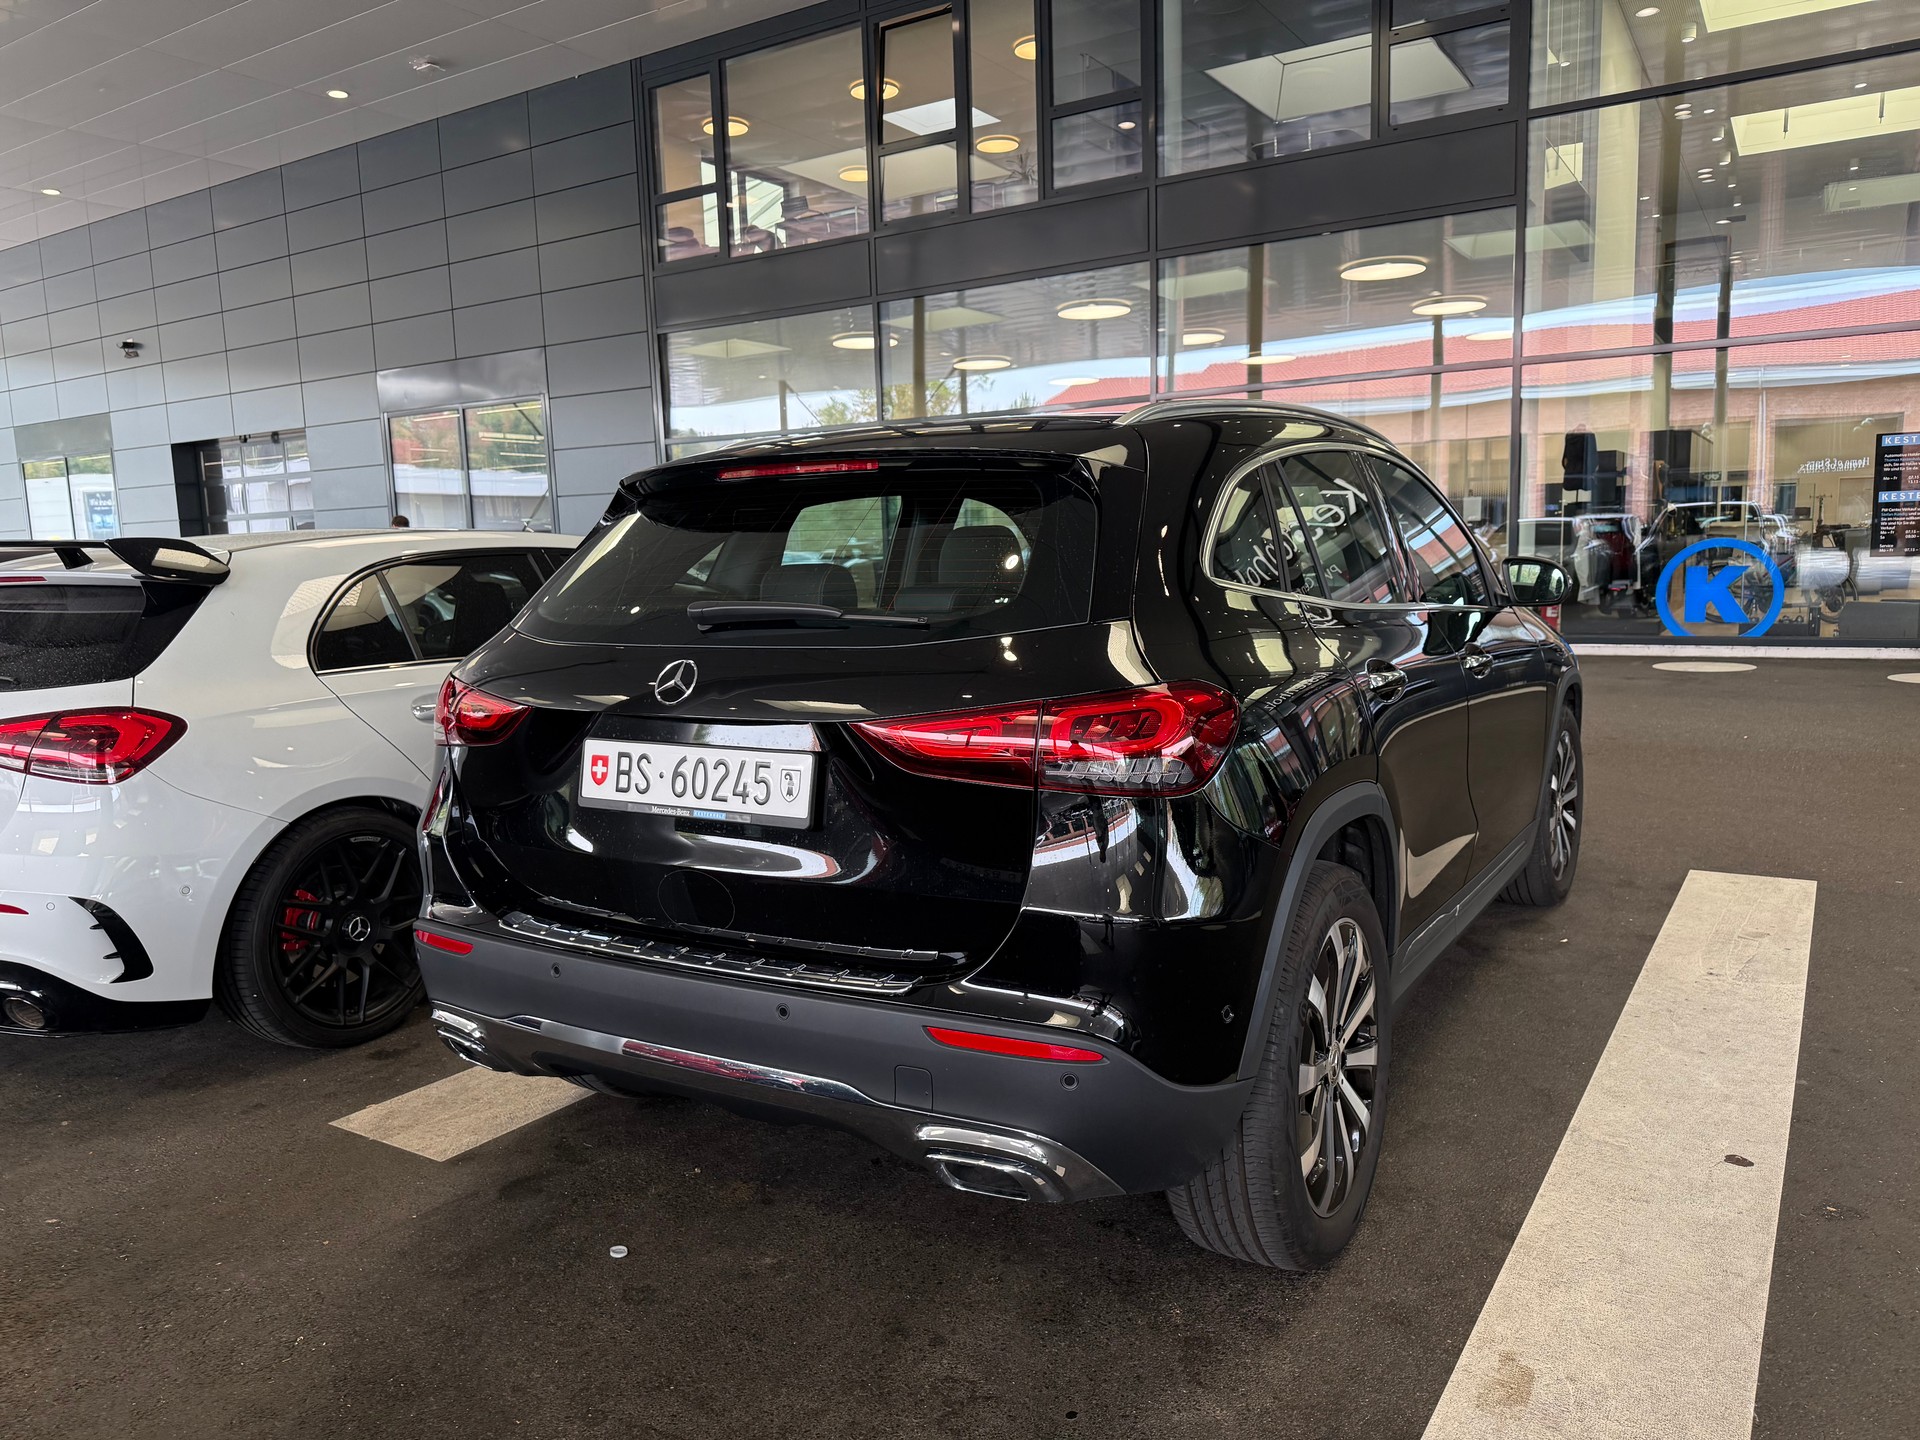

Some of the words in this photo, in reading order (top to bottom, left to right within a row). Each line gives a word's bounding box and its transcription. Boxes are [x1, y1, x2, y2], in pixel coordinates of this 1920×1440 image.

[1885, 435, 1918, 445] KEST
[1684, 566, 1751, 623] K
[651, 805, 690, 817] Mercedes-Benz
